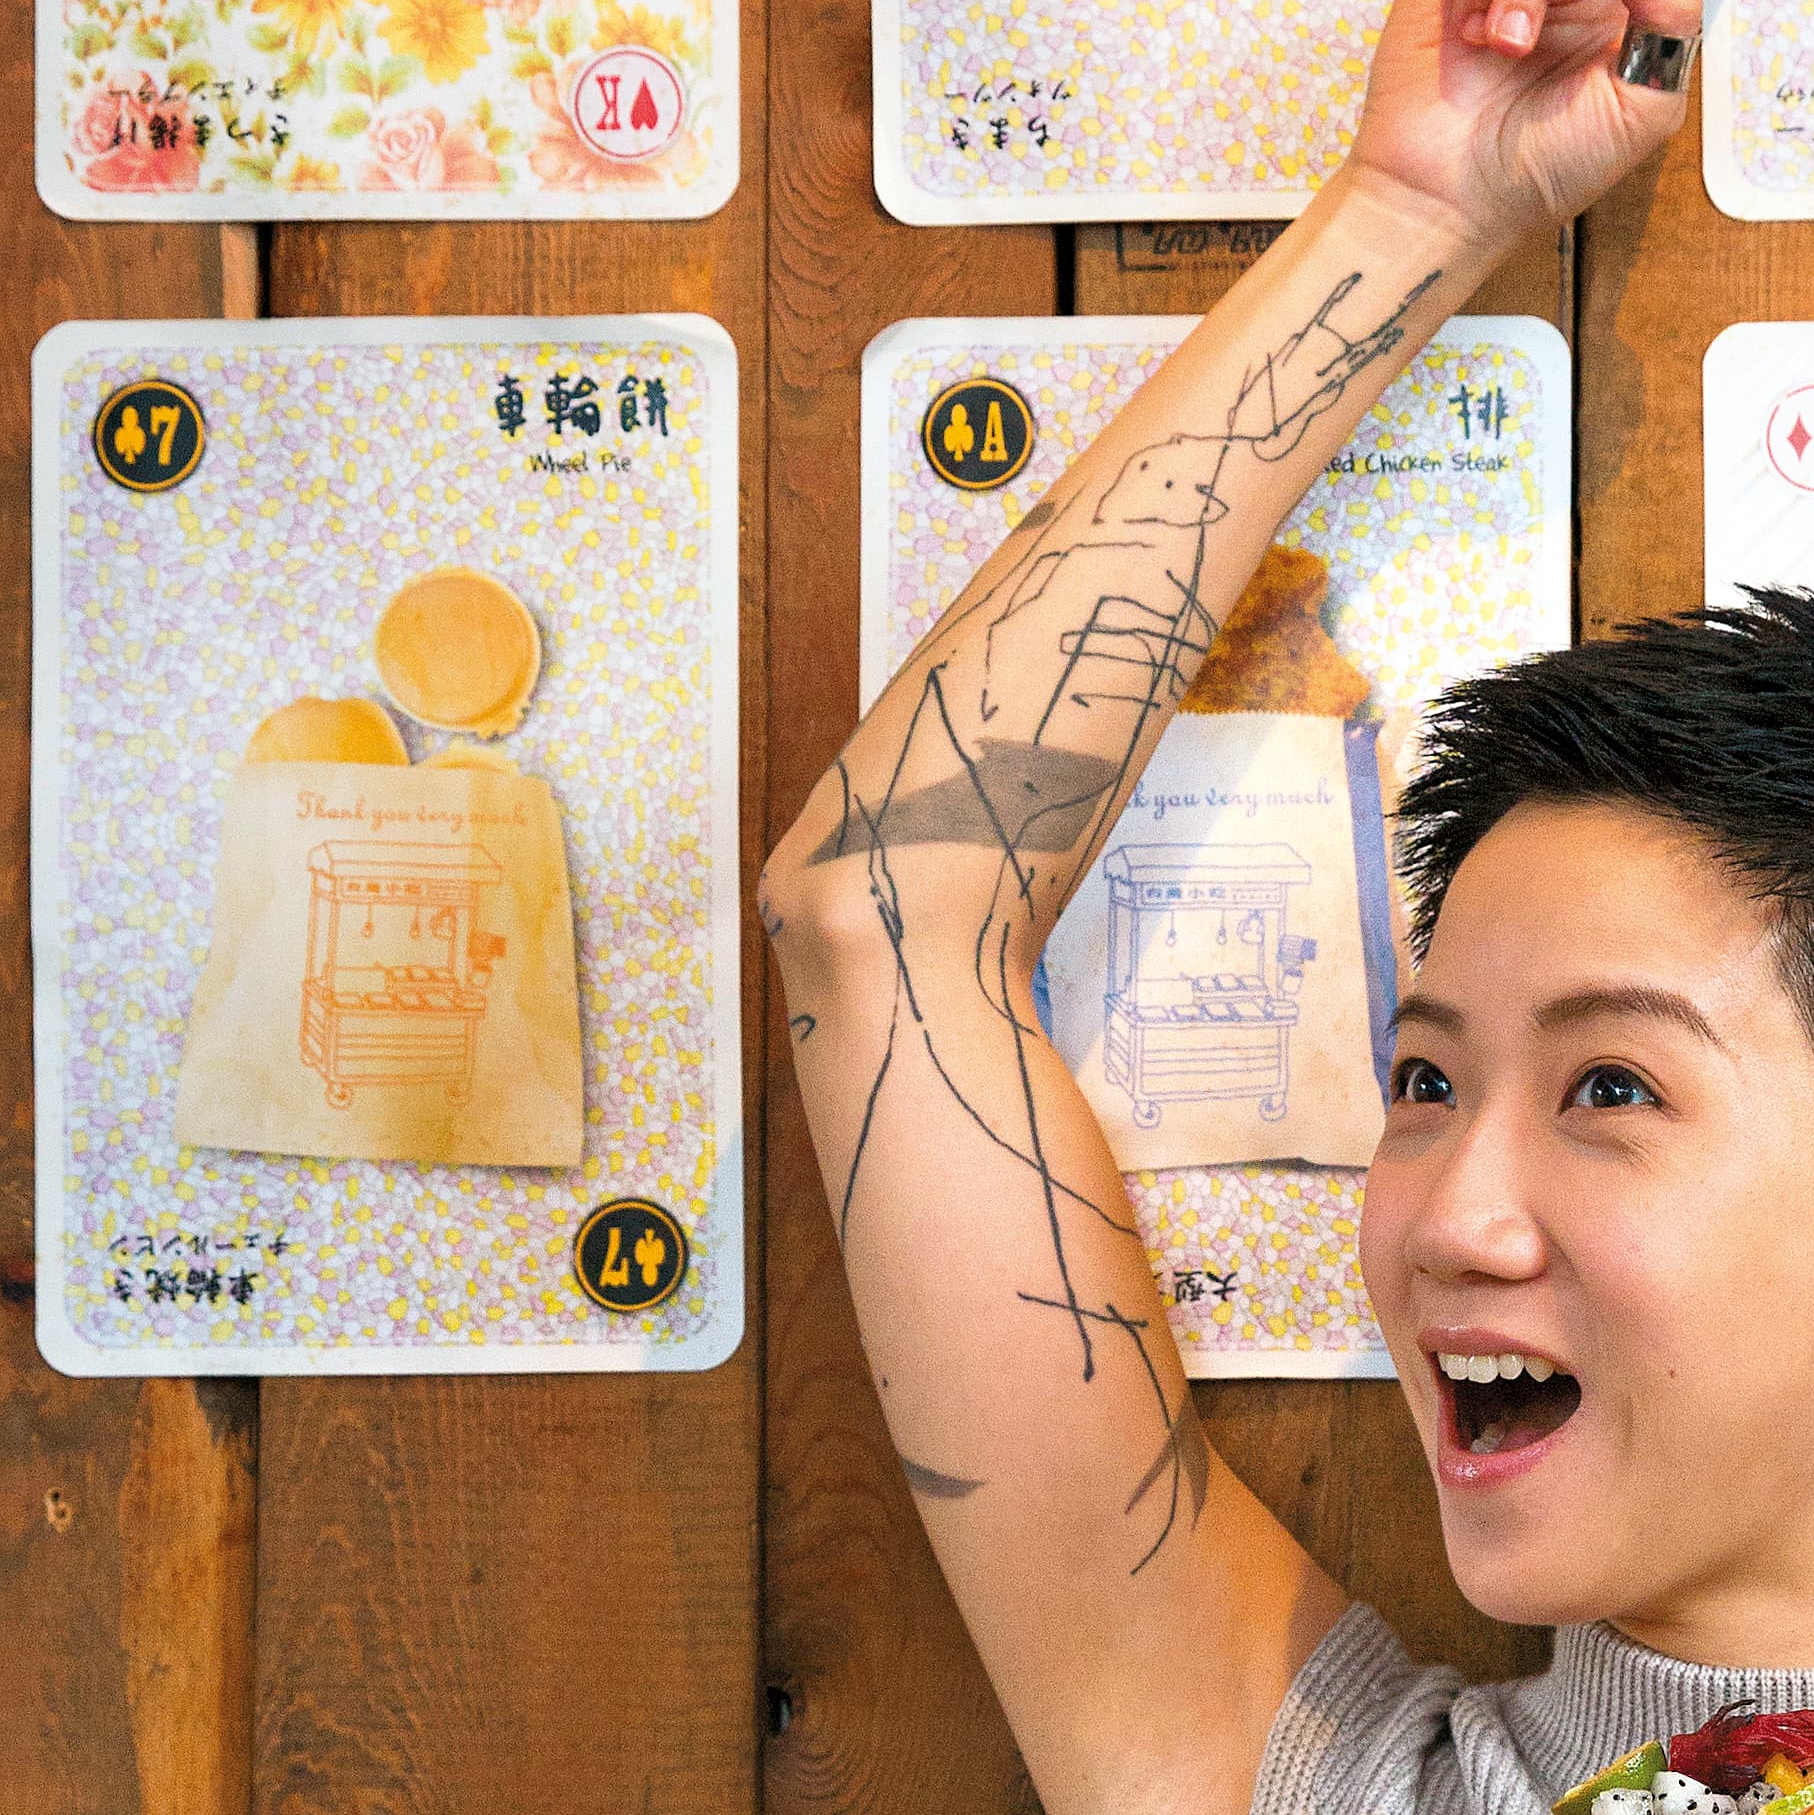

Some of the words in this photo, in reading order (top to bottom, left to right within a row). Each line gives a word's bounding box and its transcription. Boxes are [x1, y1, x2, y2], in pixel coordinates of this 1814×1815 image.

[595, 75, 622, 131] K
[107, 114, 291, 151] さつま揚げ
[952, 116, 1050, 151] ちまき
[495, 373, 668, 438] 車輪餅
[150, 405, 180, 466] 7
[980, 401, 1008, 462] A
[529, 448, 588, 475] Wheel
[602, 452, 632, 473] Pie
[1364, 451, 1442, 475] Chicken
[1452, 449, 1507, 473] Steak
[296, 790, 366, 820] Thank
[371, 808, 410, 831] you
[1152, 794, 1199, 821] you
[1204, 787, 1258, 819] very
[1266, 776, 1332, 805] much
[599, 1227, 630, 1288] 7
[114, 1267, 259, 1305] 車輪焼き
[1152, 1271, 1238, 1304] 大型
